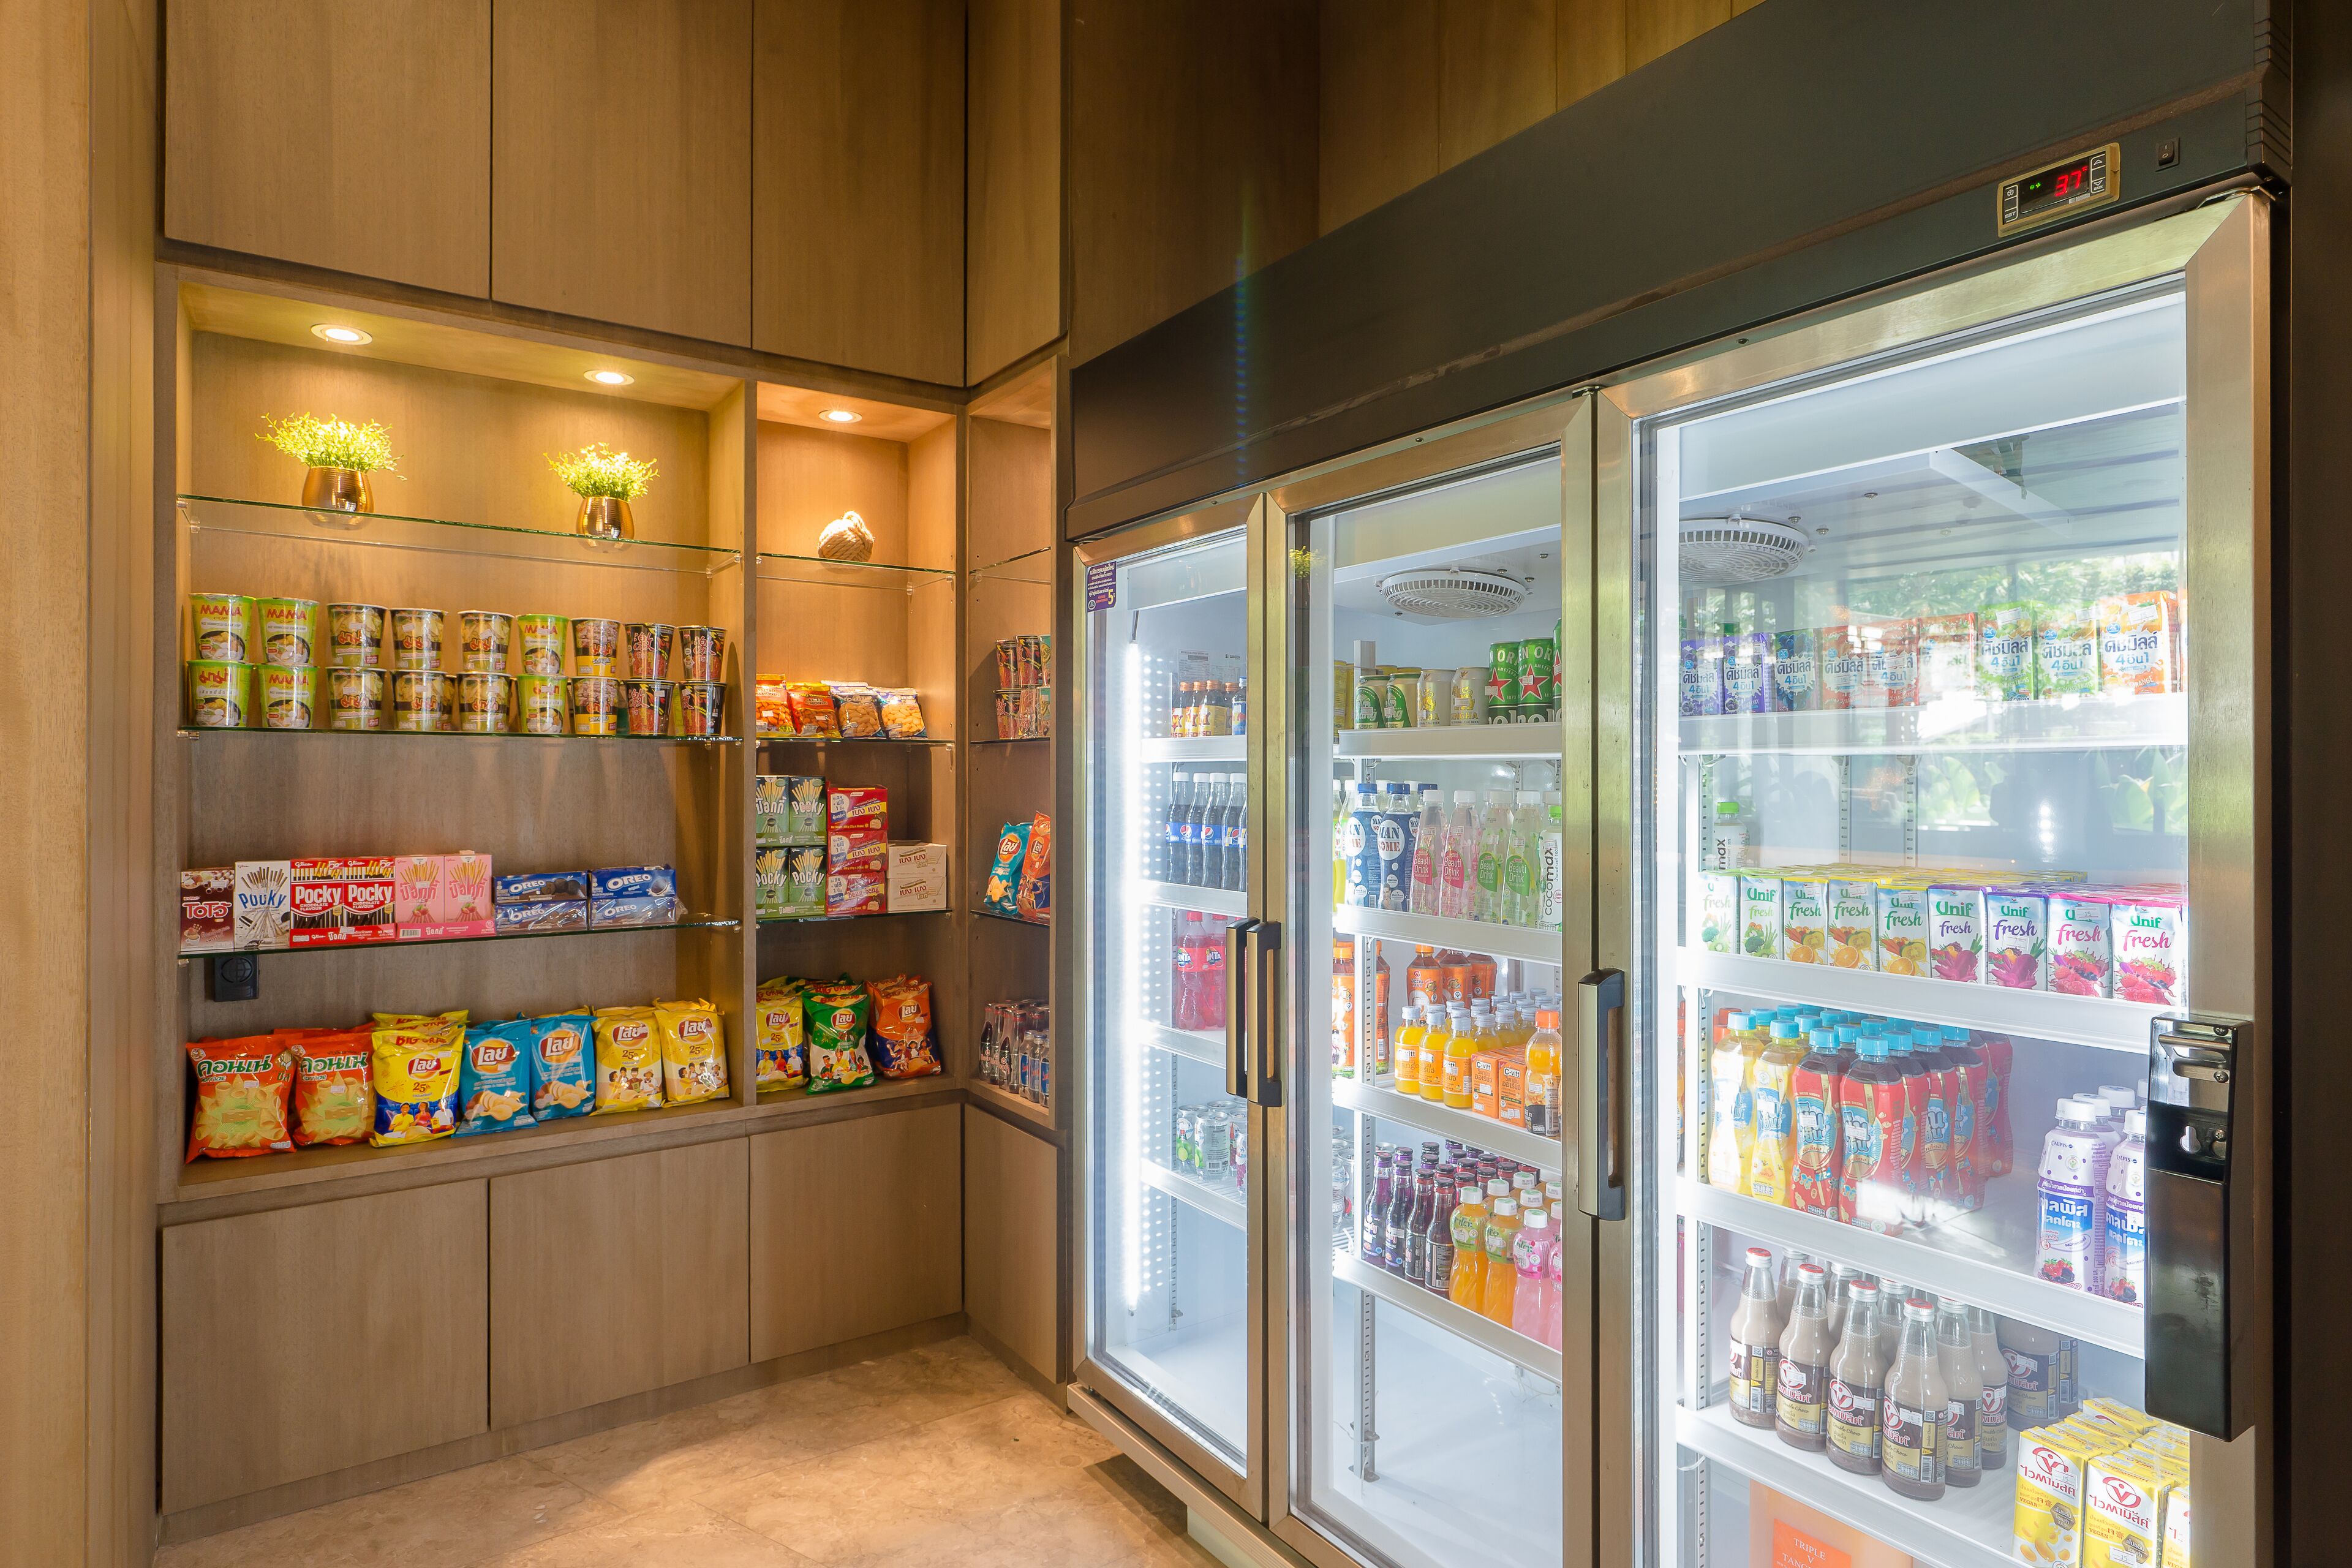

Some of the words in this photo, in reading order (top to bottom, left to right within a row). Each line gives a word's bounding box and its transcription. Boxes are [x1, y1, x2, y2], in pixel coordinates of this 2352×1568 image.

[1108, 589, 1114, 605] 5
[201, 605, 243, 617] MAMA
[267, 608, 307, 620] MAMA
[1777, 658, 1812, 675] ดัชมิลล์
[1414, 855, 1430, 865] Beauti
[1444, 857, 1462, 868] Beauti
[1480, 860, 1495, 870] Beauti
[1414, 864, 1429, 874] Drink
[1444, 867, 1460, 876] Drink
[1480, 869, 1493, 880] Drink
[1509, 862, 1527, 873] Beauti
[606, 873, 652, 891] OREO
[791, 869, 825, 886] Pocky
[1509, 873, 1525, 883] Drink
[1544, 848, 1555, 916] cocomax
[348, 883, 393, 904] Pocky
[510, 880, 546, 894] OREO
[295, 885, 342, 906] Pocky
[1746, 888, 1776, 902] Unif
[1703, 894, 1732, 911] fresh
[1935, 900, 1975, 916] Unif
[510, 908, 545, 923] OREO
[604, 904, 637, 918] OREO
[1748, 905, 1774, 920] fresh
[1789, 902, 1822, 921] fresh
[1833, 901, 1871, 920] fresh
[2000, 905, 2030, 918] Unif
[1884, 910, 1923, 930] fresh
[2130, 916, 2163, 928] Unif
[1939, 920, 1973, 937] fresh
[1992, 919, 2038, 940] fresh
[2056, 923, 2102, 945] fresh
[2121, 930, 2172, 952] fresh
[835, 1012, 854, 1026] เลย์
[396, 1036, 420, 1046] BIG
[545, 1031, 576, 1057] เลย์
[477, 1043, 510, 1066] เลย์
[197, 1054, 273, 1078] คอนเน่
[300, 1052, 369, 1075] คอนเน่
[412, 1057, 438, 1074] เลย์
[1477, 1061, 1491, 1070] C-vitt
[1504, 1068, 1520, 1078] C-vitt
[1833, 1422, 1845, 1433] Double
[1846, 1428, 1862, 1436] Choco
[1893, 1448, 1907, 1457] Choco
[2019, 1496, 2038, 1507] VEGAN
[2089, 1528, 2109, 1540] VEGAN
[1793, 1537, 1826, 1561] TRIPLE
[1807, 1555, 1815, 1564] V
